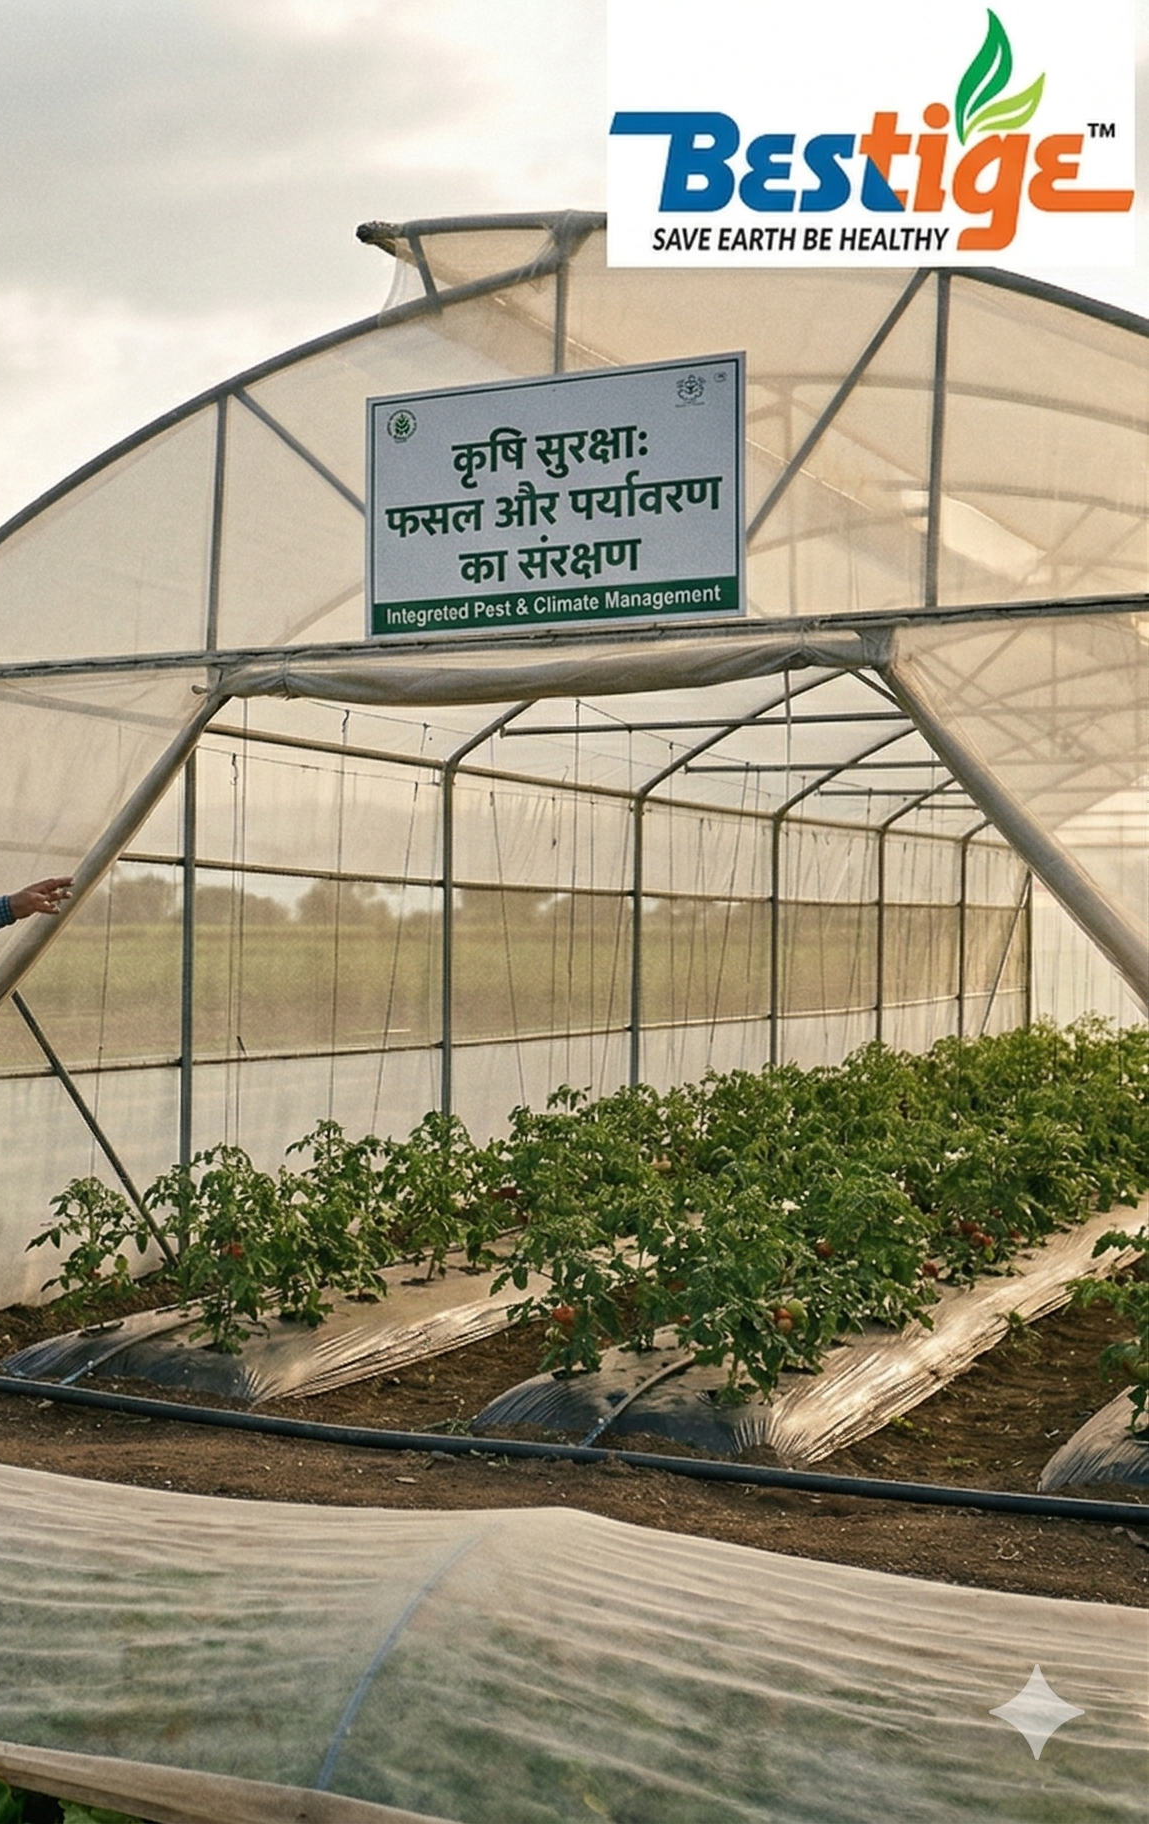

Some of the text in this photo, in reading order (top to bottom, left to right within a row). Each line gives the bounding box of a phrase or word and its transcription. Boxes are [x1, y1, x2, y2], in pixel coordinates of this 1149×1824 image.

[452, 426, 527, 489] कृषि
[385, 470, 724, 538] फसल और पर्यावरण
[458, 535, 642, 584] का संरक्षण
[474, 600, 511, 618] Pest
[515, 597, 529, 616] &
[533, 594, 600, 614] Climate
[604, 584, 721, 610] Management
